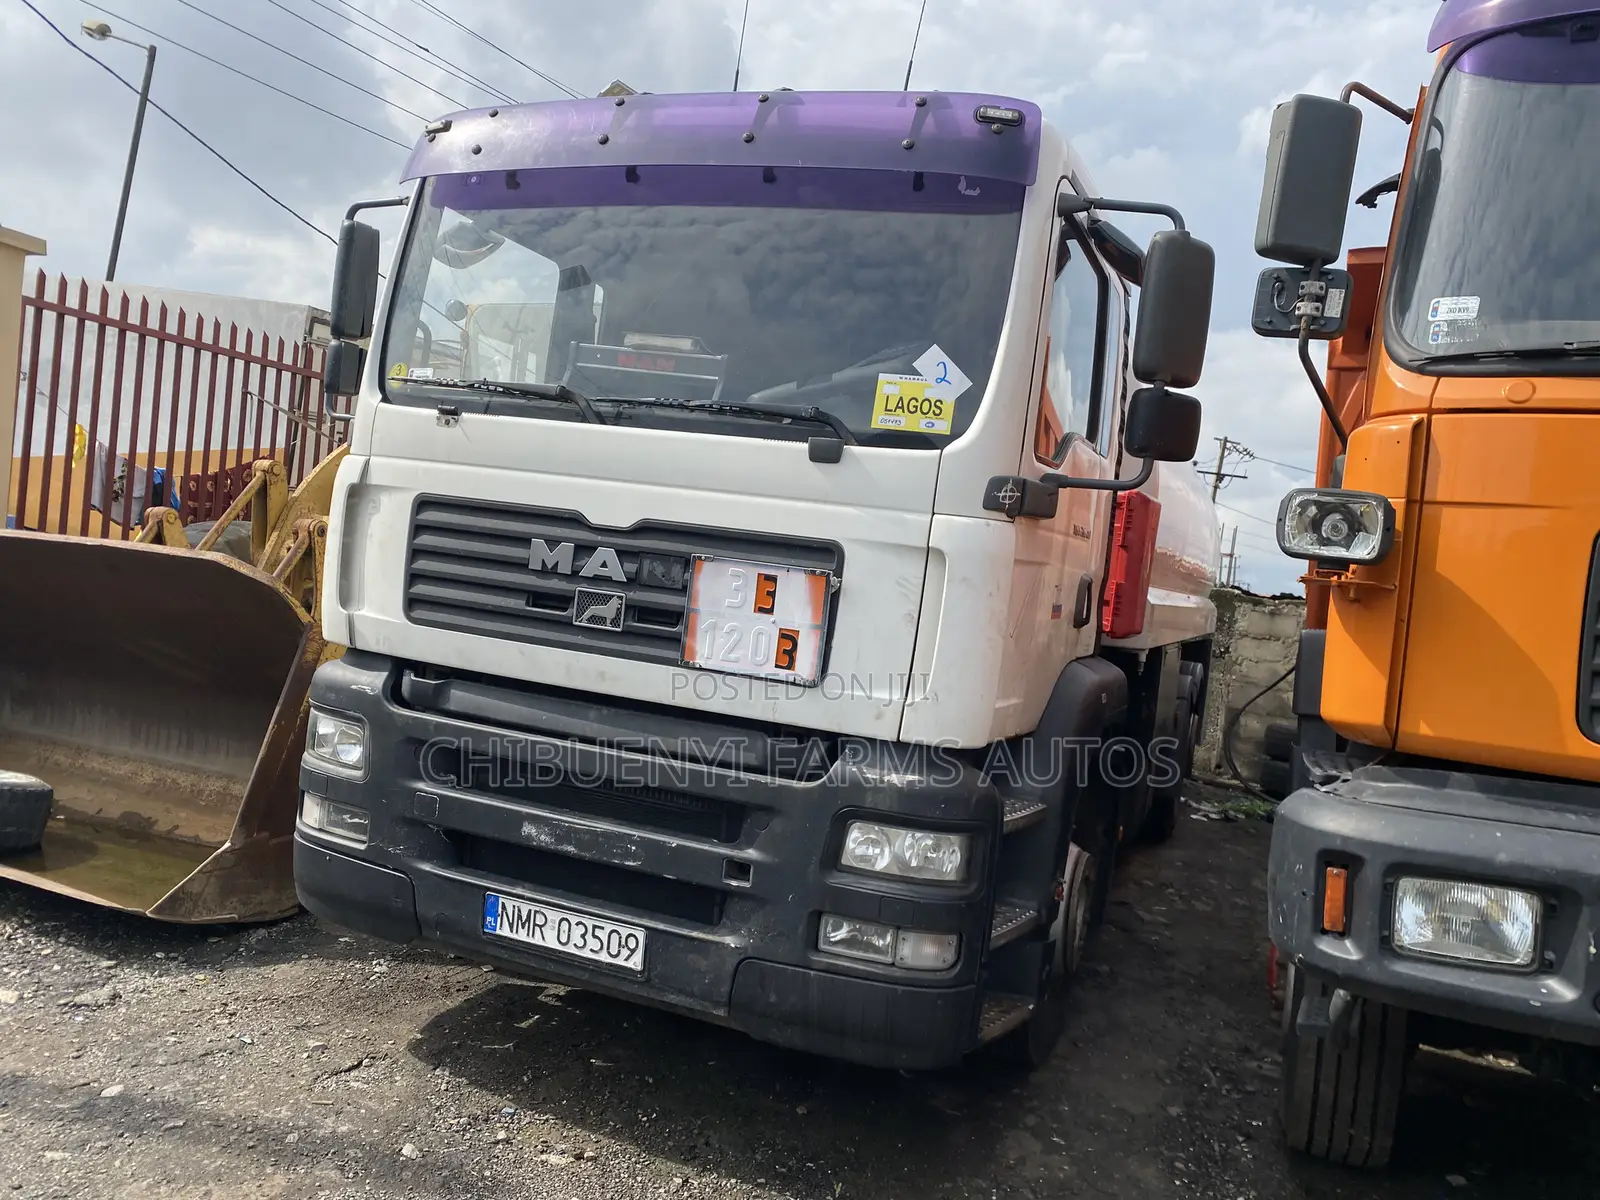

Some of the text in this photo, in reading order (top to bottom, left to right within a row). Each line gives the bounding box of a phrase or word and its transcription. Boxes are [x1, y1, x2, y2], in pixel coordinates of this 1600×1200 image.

[395, 364, 403, 376] 3
[936, 361, 952, 386] 2
[884, 395, 944, 417] LAGOS
[700, 618, 799, 671] 1203
[485, 901, 640, 962] PL NMR 03509
